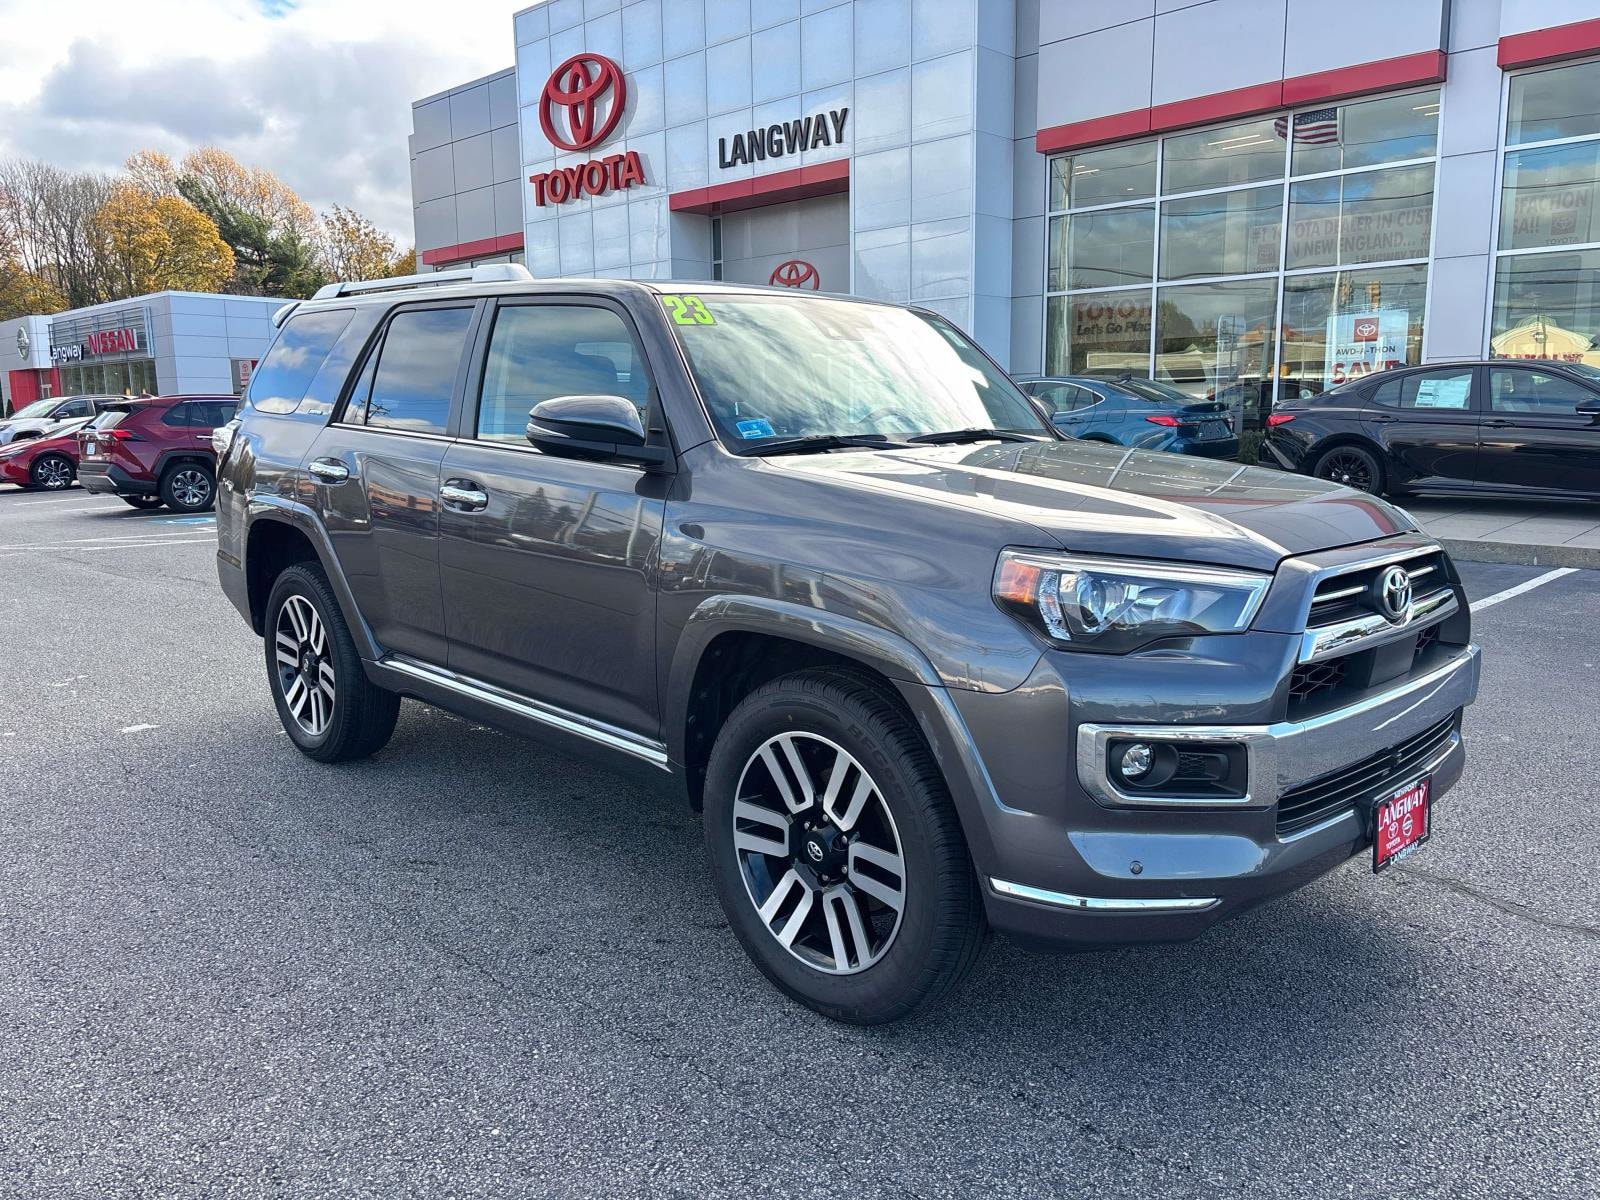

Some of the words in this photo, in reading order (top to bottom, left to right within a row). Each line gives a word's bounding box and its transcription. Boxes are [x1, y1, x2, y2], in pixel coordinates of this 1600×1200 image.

[718, 108, 849, 169] LANGWAY
[529, 151, 646, 207] TOYOTA
[1377, 211, 1393, 229] IN
[1304, 238, 1334, 257] NEW
[661, 295, 716, 326] 23
[1106, 322, 1123, 334] Go
[50, 344, 83, 363] Langway
[87, 327, 138, 355] NISSAN
[1335, 345, 1396, 356] AWD-A-THON
[1378, 785, 1427, 832] LANGWAY
[1389, 840, 1419, 866] LANGWAY
